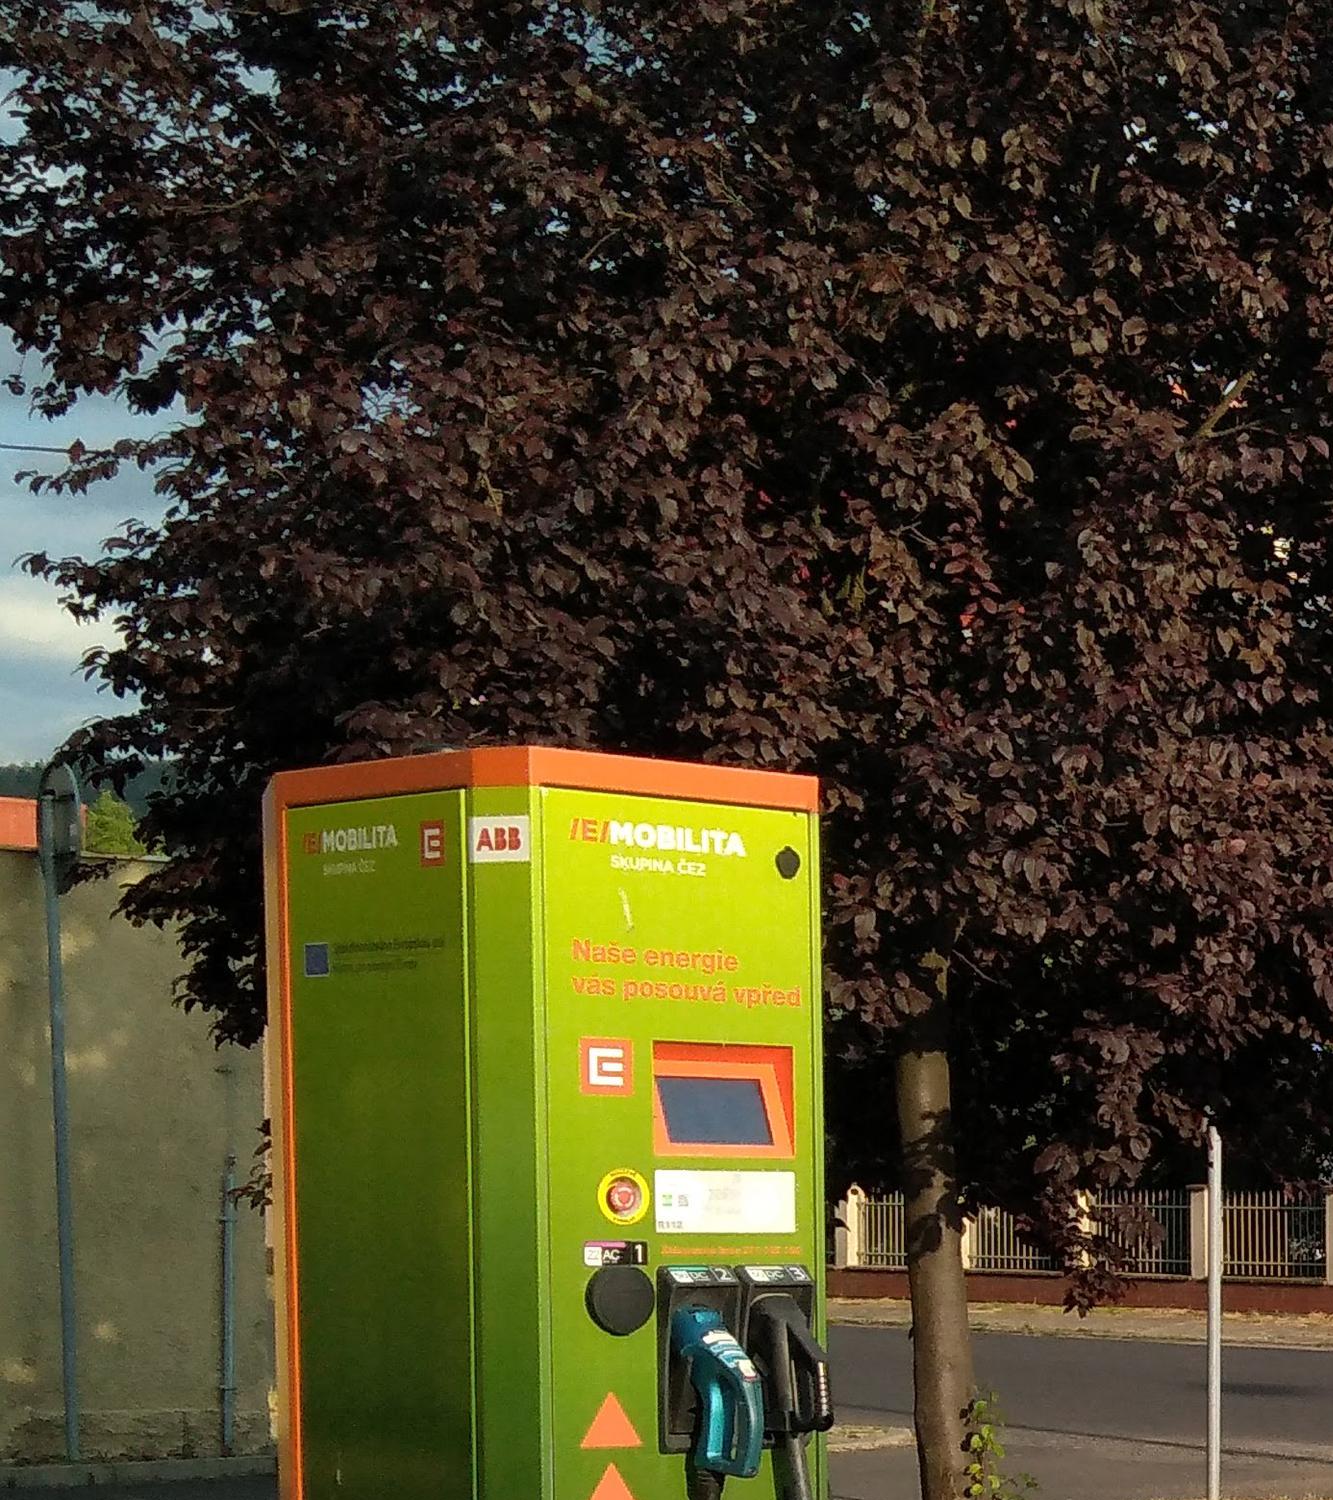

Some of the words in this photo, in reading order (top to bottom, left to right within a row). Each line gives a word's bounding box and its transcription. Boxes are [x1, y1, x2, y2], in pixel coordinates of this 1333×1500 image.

[476, 827, 522, 851] ABB
[610, 855, 674, 873] SKUPINA
[677, 858, 706, 877] ČEZ
[572, 938, 636, 964] Naše
[644, 949, 739, 975] energie
[571, 973, 616, 996] vás
[622, 980, 727, 1002] posouvá
[733, 984, 801, 1009] vpřed
[602, 1249, 621, 1261] AC
[634, 1244, 643, 1264] 1
[714, 1268, 732, 1281] 2
[790, 1267, 807, 1281] 3
